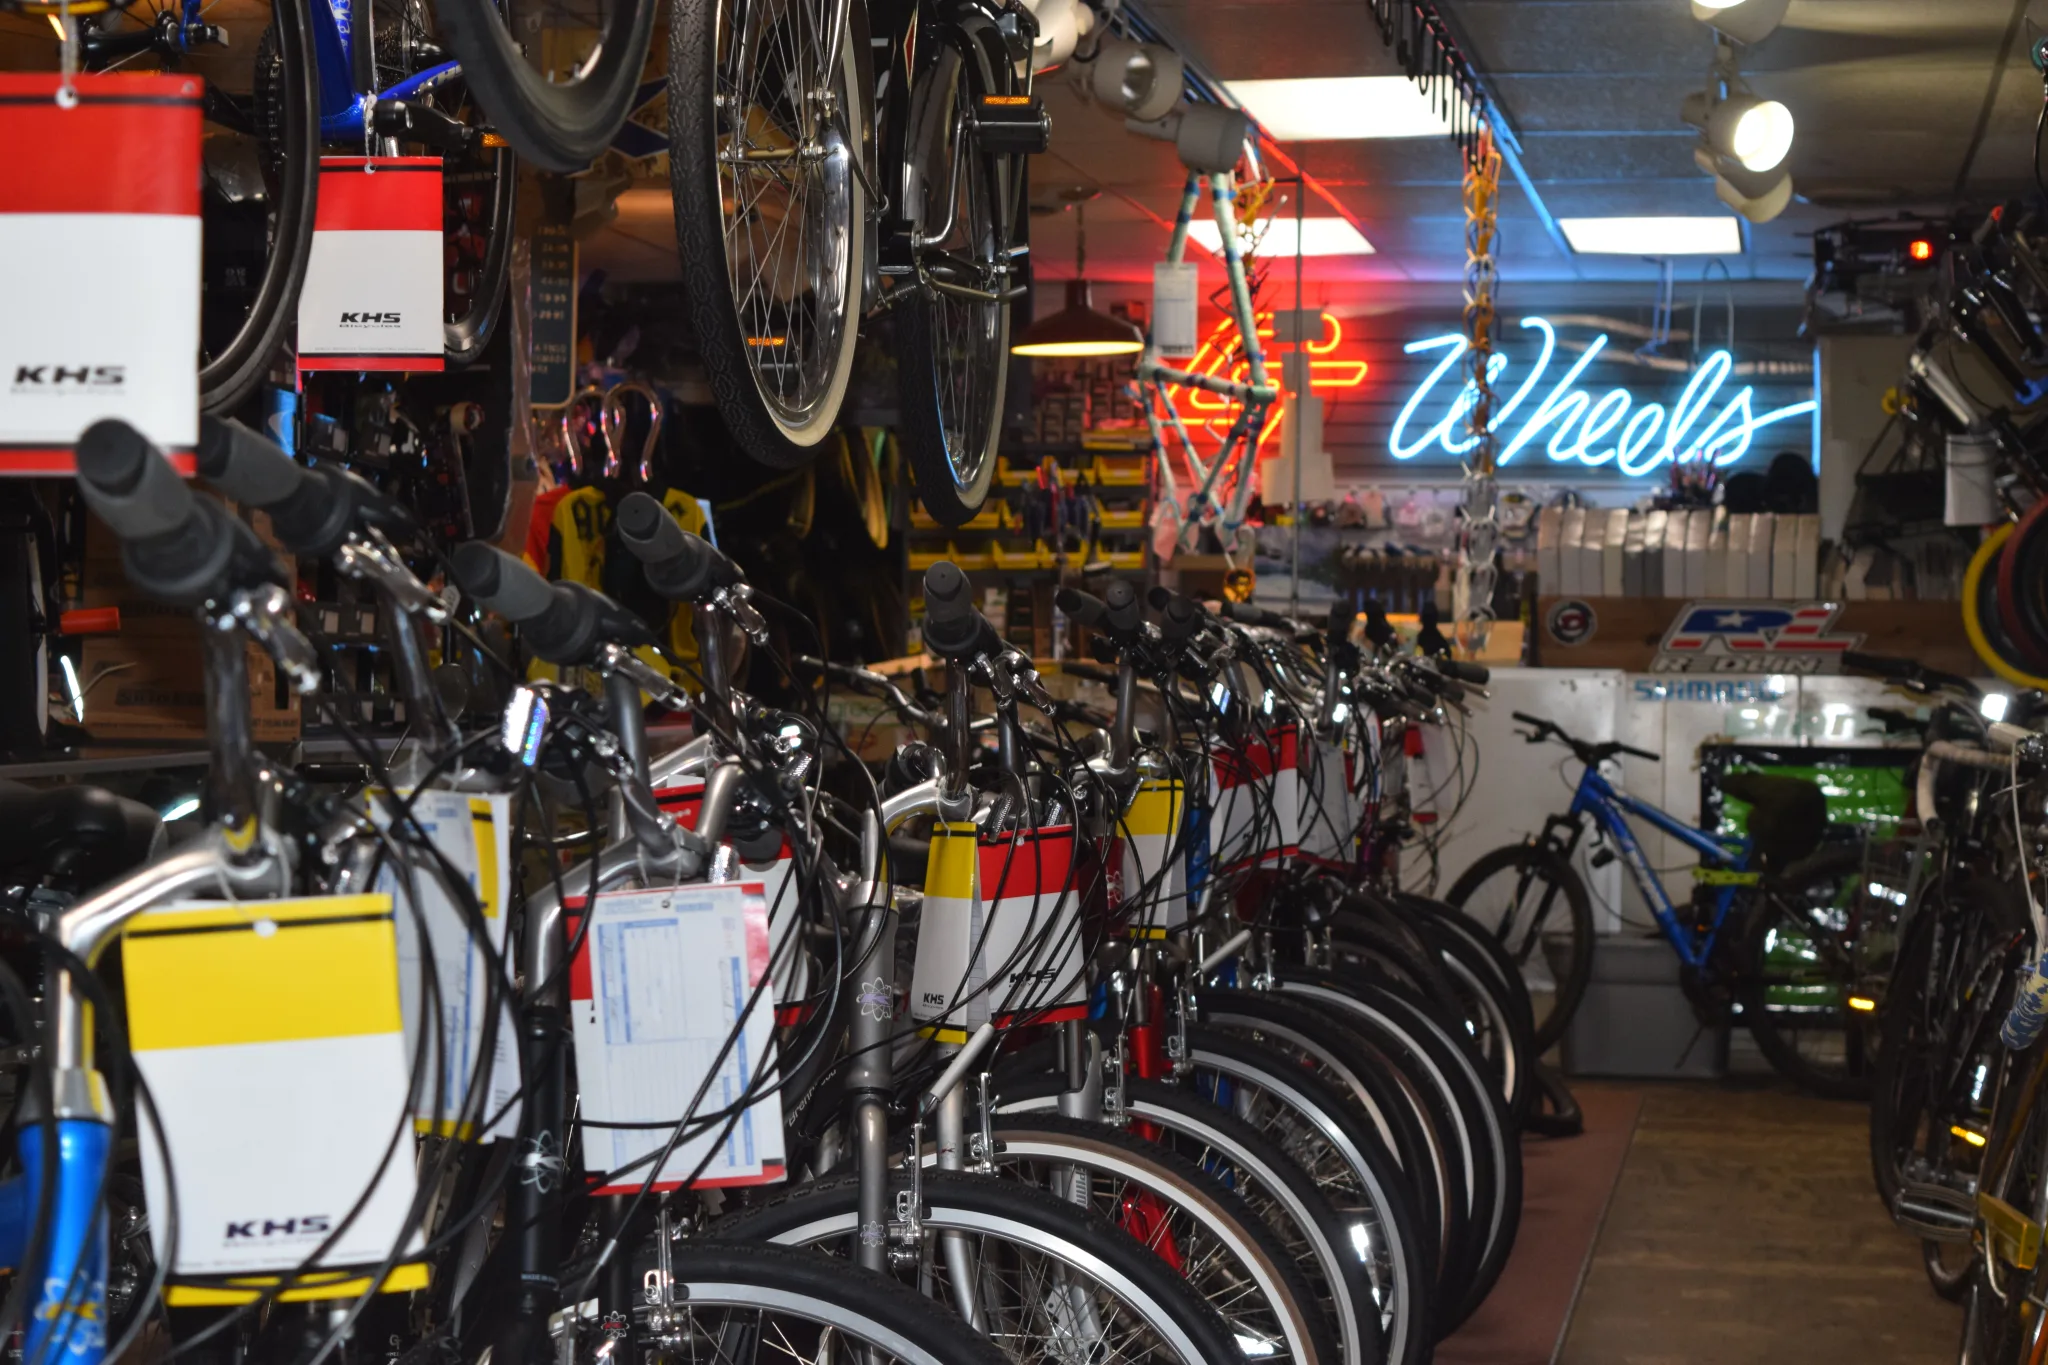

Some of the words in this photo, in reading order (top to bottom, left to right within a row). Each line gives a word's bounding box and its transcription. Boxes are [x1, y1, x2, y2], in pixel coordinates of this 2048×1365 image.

[339, 312, 401, 323] KHS
[15, 365, 126, 384] KHS
[1388, 315, 1818, 477] Wheels
[923, 992, 945, 1005] KHS
[226, 1214, 330, 1238] KHS
